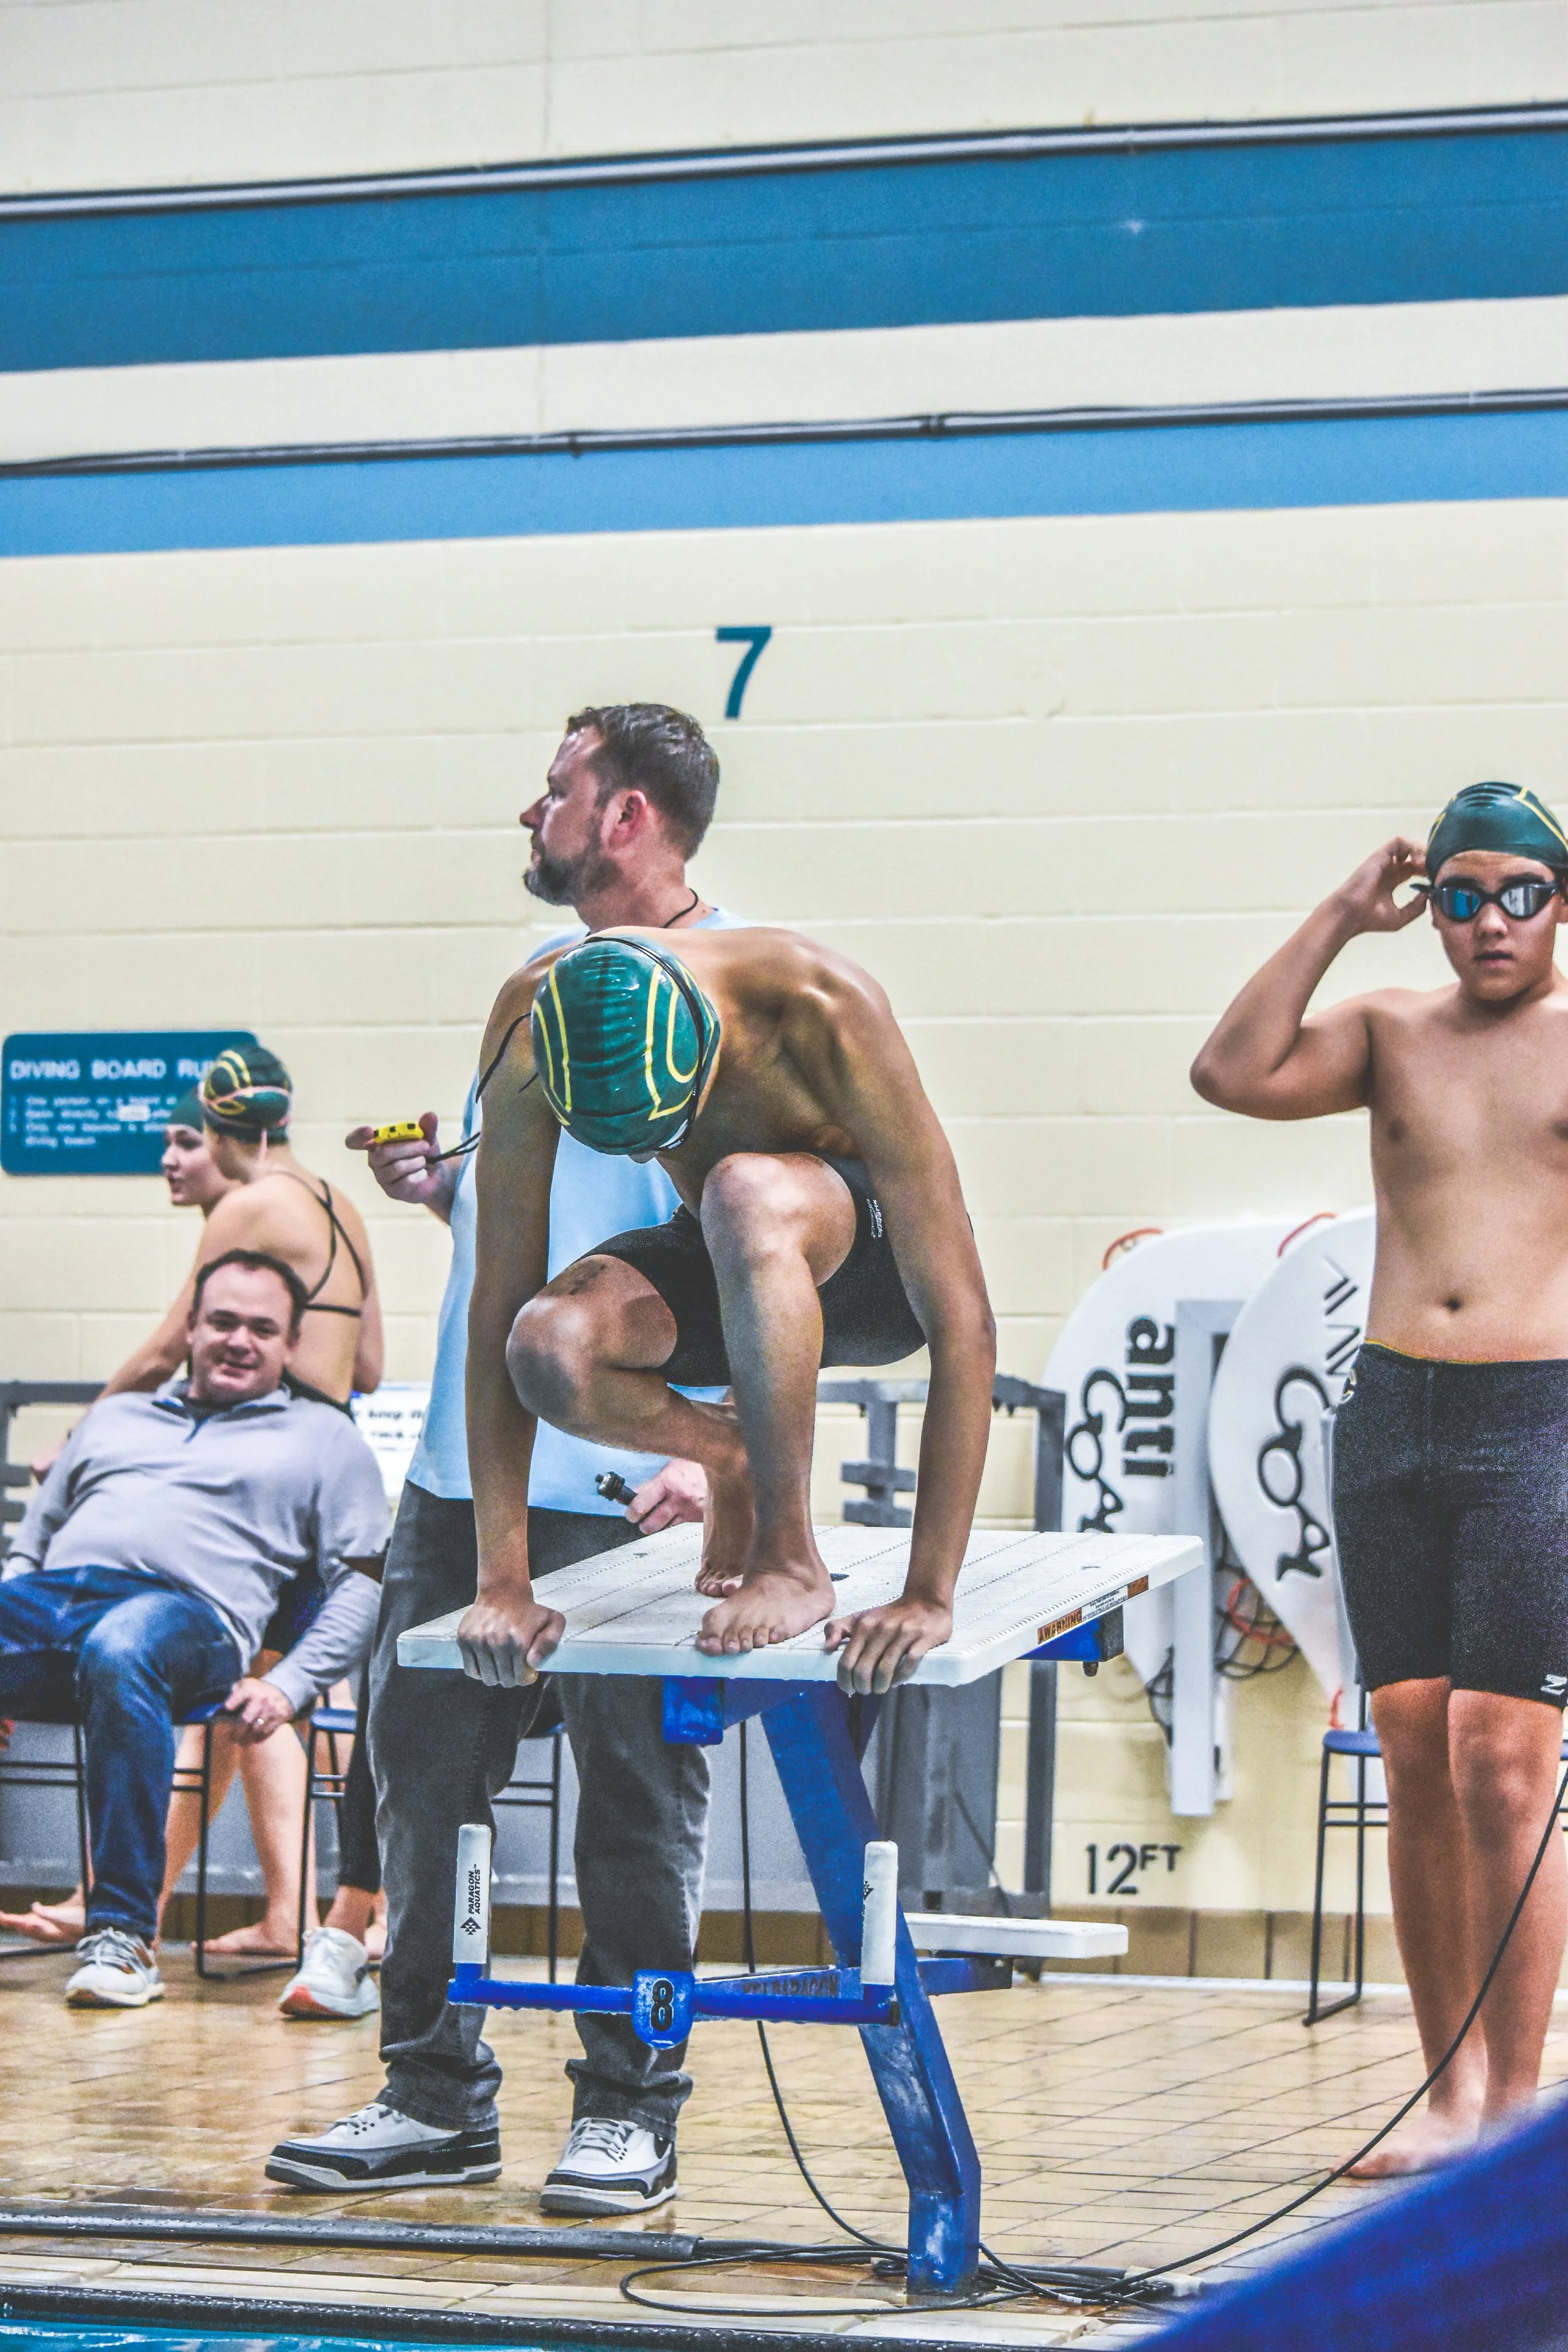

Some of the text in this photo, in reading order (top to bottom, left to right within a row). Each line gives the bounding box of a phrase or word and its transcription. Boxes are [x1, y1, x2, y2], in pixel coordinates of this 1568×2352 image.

[716, 625, 772, 719] 7
[9, 1059, 81, 1080] DIVING
[91, 1058, 167, 1080] BOARD
[1124, 1315, 1175, 1477] anti
[650, 1979, 674, 2032] 8
